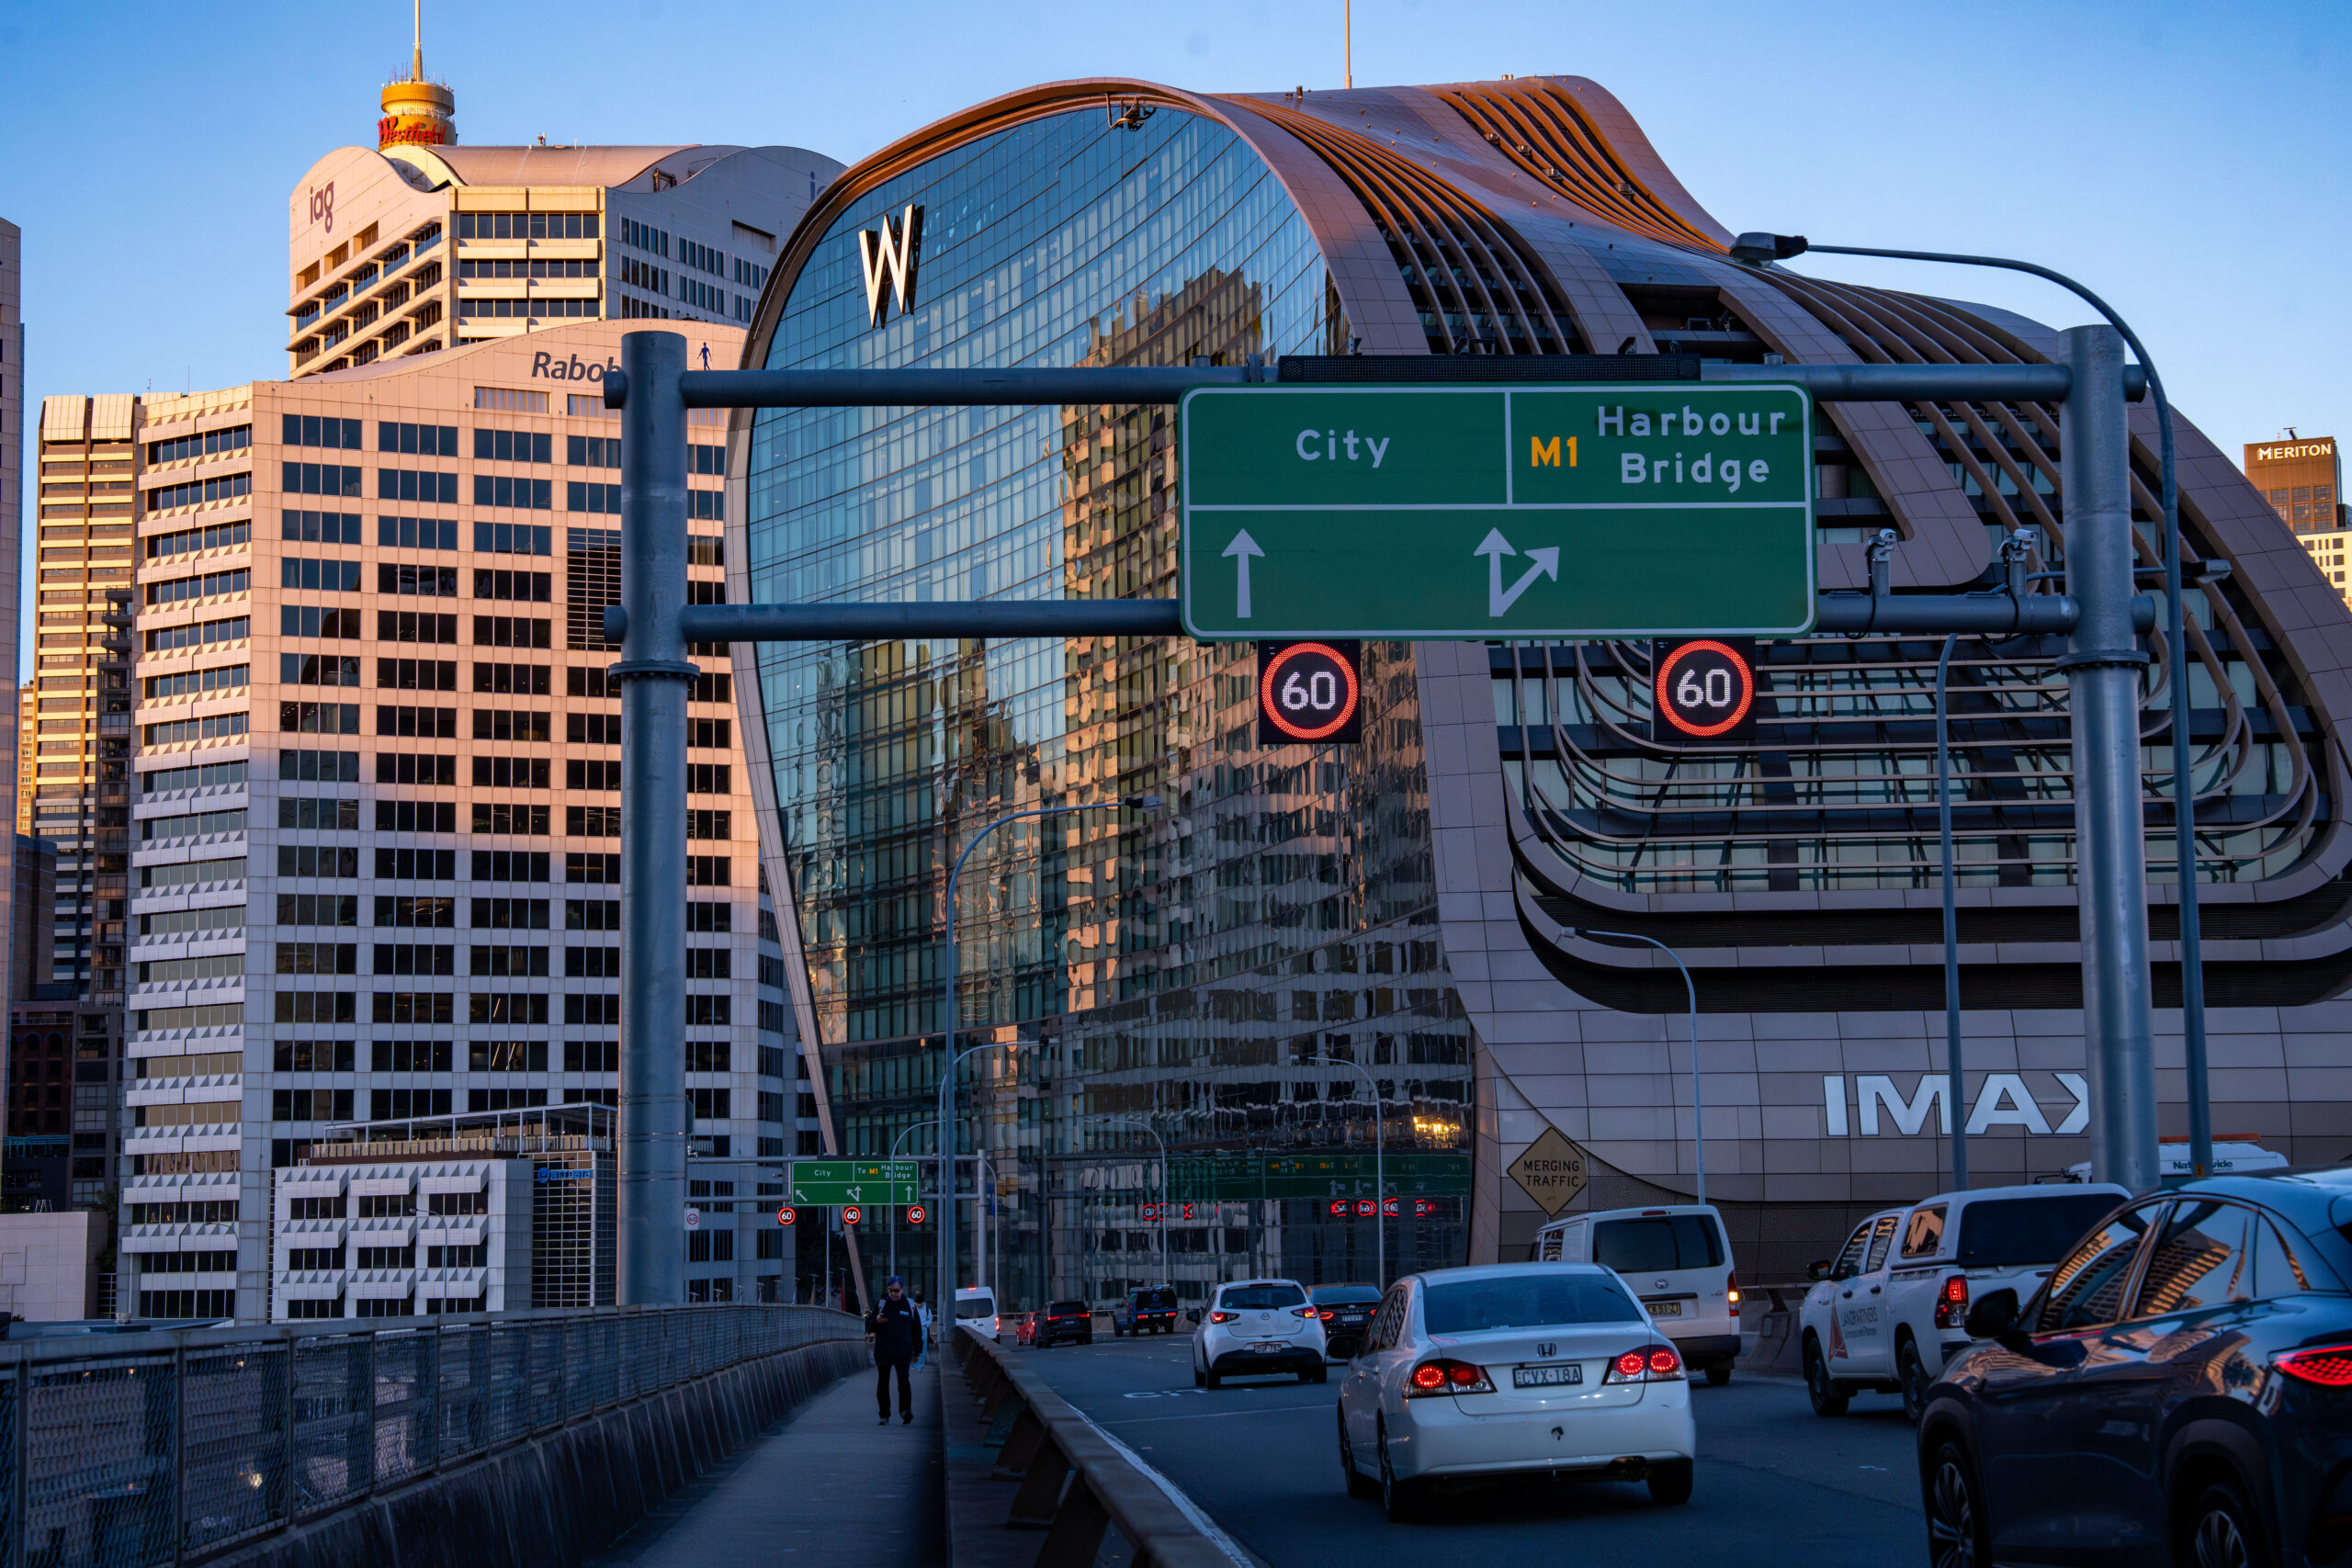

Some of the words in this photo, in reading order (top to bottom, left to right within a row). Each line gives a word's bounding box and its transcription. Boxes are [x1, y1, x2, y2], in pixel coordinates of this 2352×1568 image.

[378, 116, 448, 144] Westfield
[310, 180, 334, 234] iag
[858, 203, 919, 329] W
[1598, 404, 1786, 437] Harbour
[1295, 429, 1390, 468] City
[1531, 435, 1577, 468] M1
[2257, 444, 2332, 460] MERITON
[1622, 453, 1770, 493] Bridge
[1282, 671, 1337, 711] 60
[1676, 668, 1731, 708] 60
[1823, 1073, 2090, 1136] IMAX
[1523, 1159, 1580, 1172] MERGING
[1524, 1174, 1580, 1188] TRAFFIC
[781, 1212, 792, 1220] 60
[846, 1212, 857, 1220] 60
[910, 1211, 922, 1219] 60
